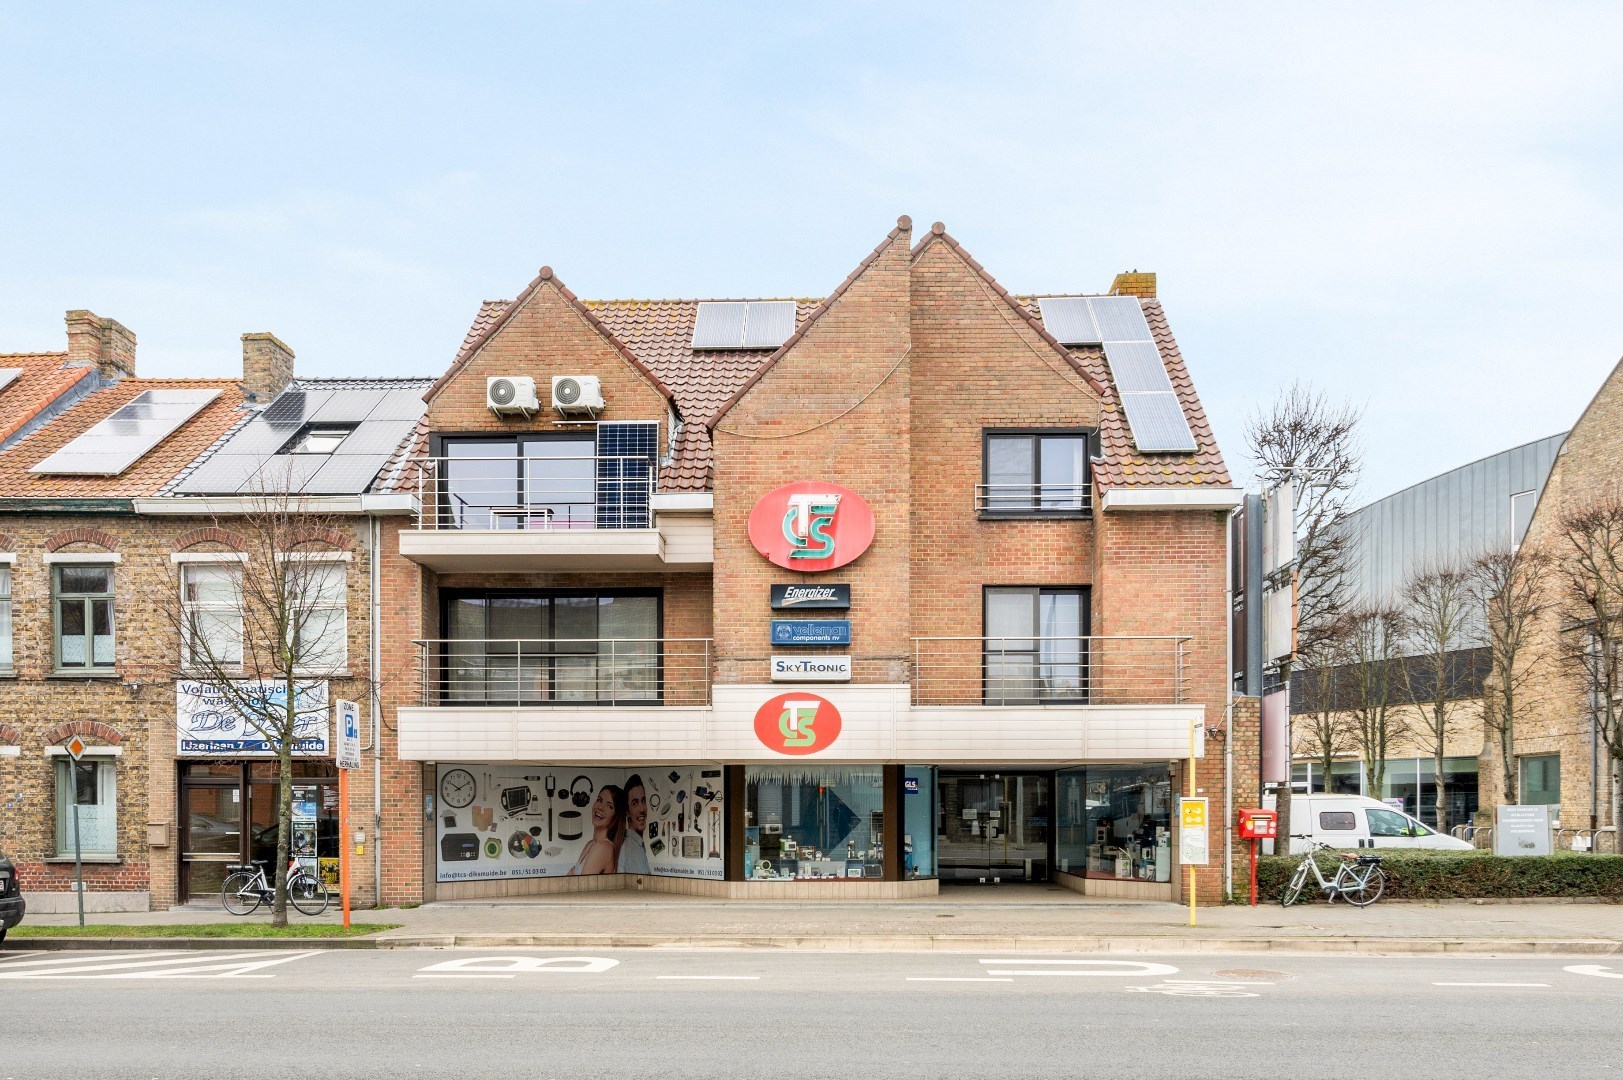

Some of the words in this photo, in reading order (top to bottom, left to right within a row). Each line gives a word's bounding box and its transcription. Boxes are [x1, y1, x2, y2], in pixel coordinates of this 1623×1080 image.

[784, 586, 836, 600] Energizer
[792, 623, 847, 636] velleman
[343, 702, 355, 712] ZONE
[189, 709, 237, 732] De
[237, 741, 244, 750] 7
[261, 741, 323, 750] Dkmuide
[439, 869, 507, 879] info@tcs-diksmuide.be
